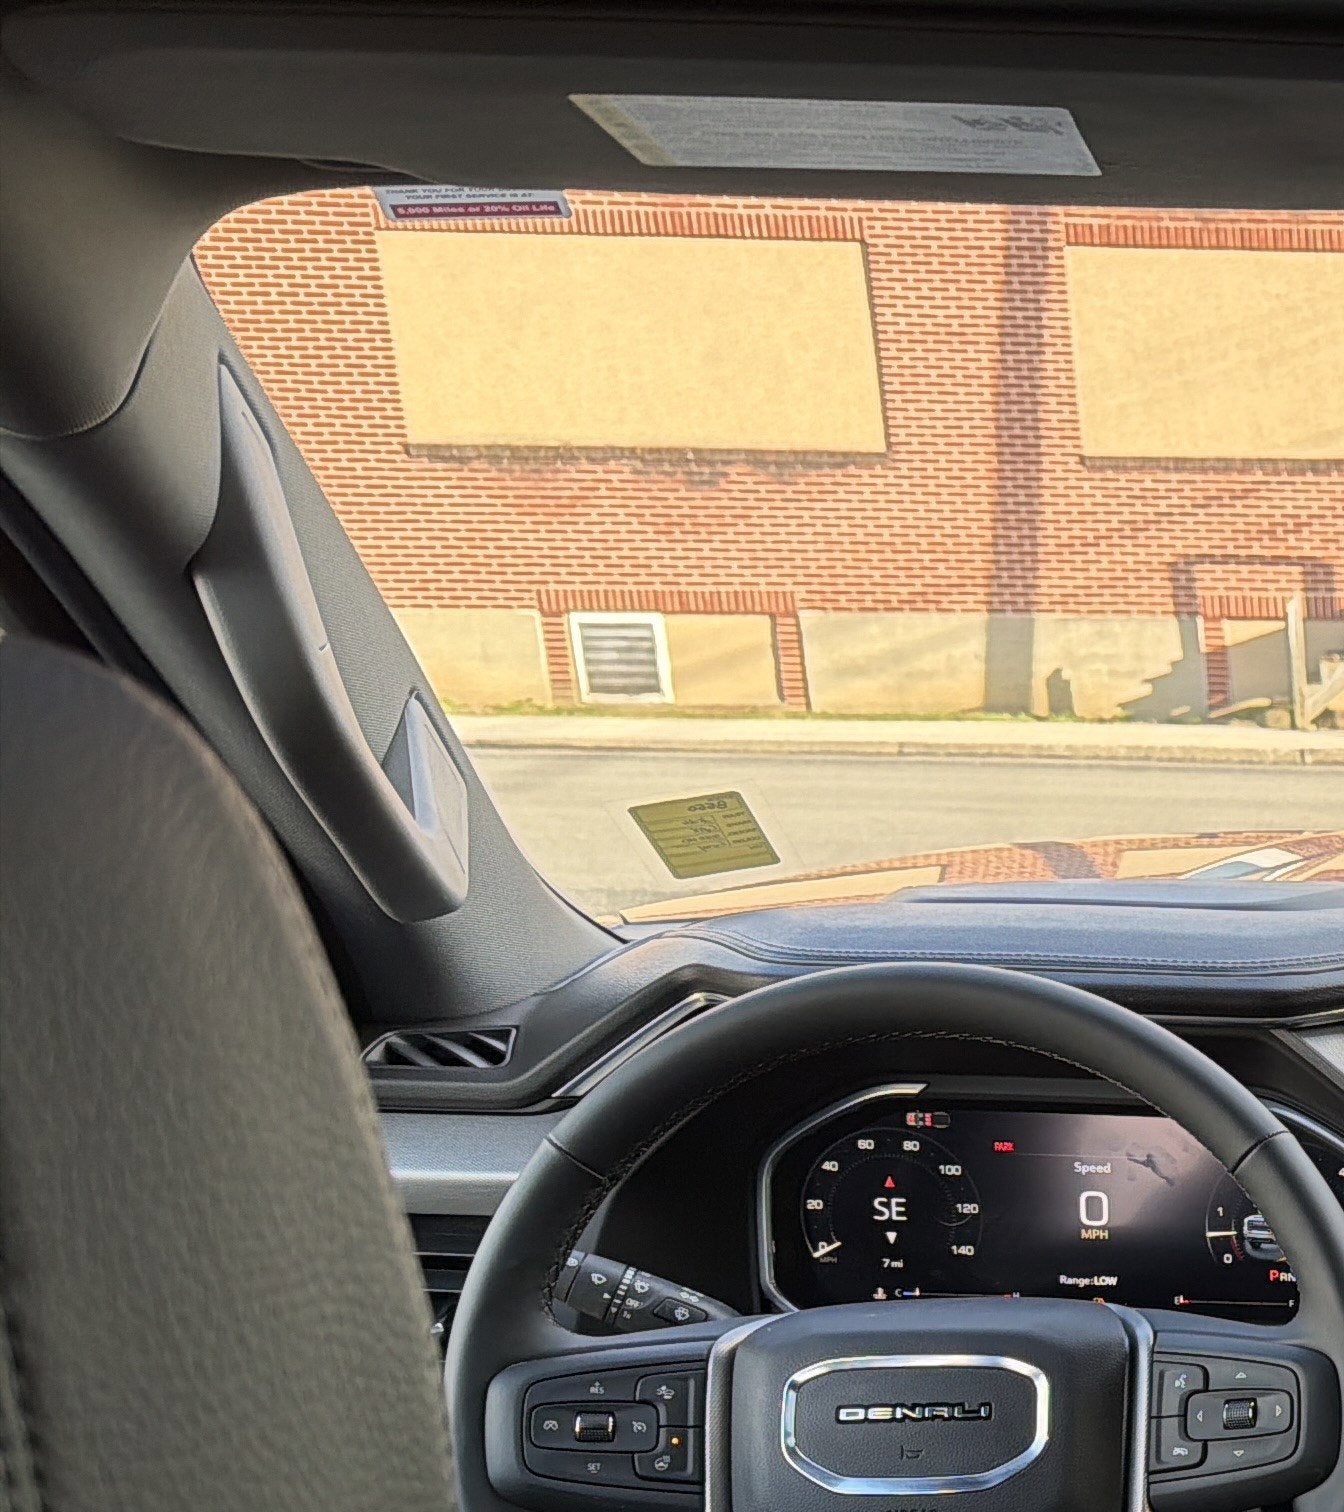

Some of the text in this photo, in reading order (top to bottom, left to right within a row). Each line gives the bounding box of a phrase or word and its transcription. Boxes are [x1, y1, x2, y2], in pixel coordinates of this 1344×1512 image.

[857, 1139, 875, 1150] 60
[903, 1141, 920, 1151] 80
[821, 1161, 839, 1172] 40
[938, 1164, 962, 1176] 100
[1073, 1161, 1112, 1175] Speed
[806, 1199, 823, 1210] 20
[872, 1197, 908, 1222] SE
[955, 1203, 979, 1214] 120
[1079, 1190, 1109, 1227] 0
[1080, 1228, 1109, 1240] MPH
[950, 1245, 975, 1256] 140
[882, 1258, 904, 1268] 7 mi
[838, 1402, 990, 1422] DENALI
